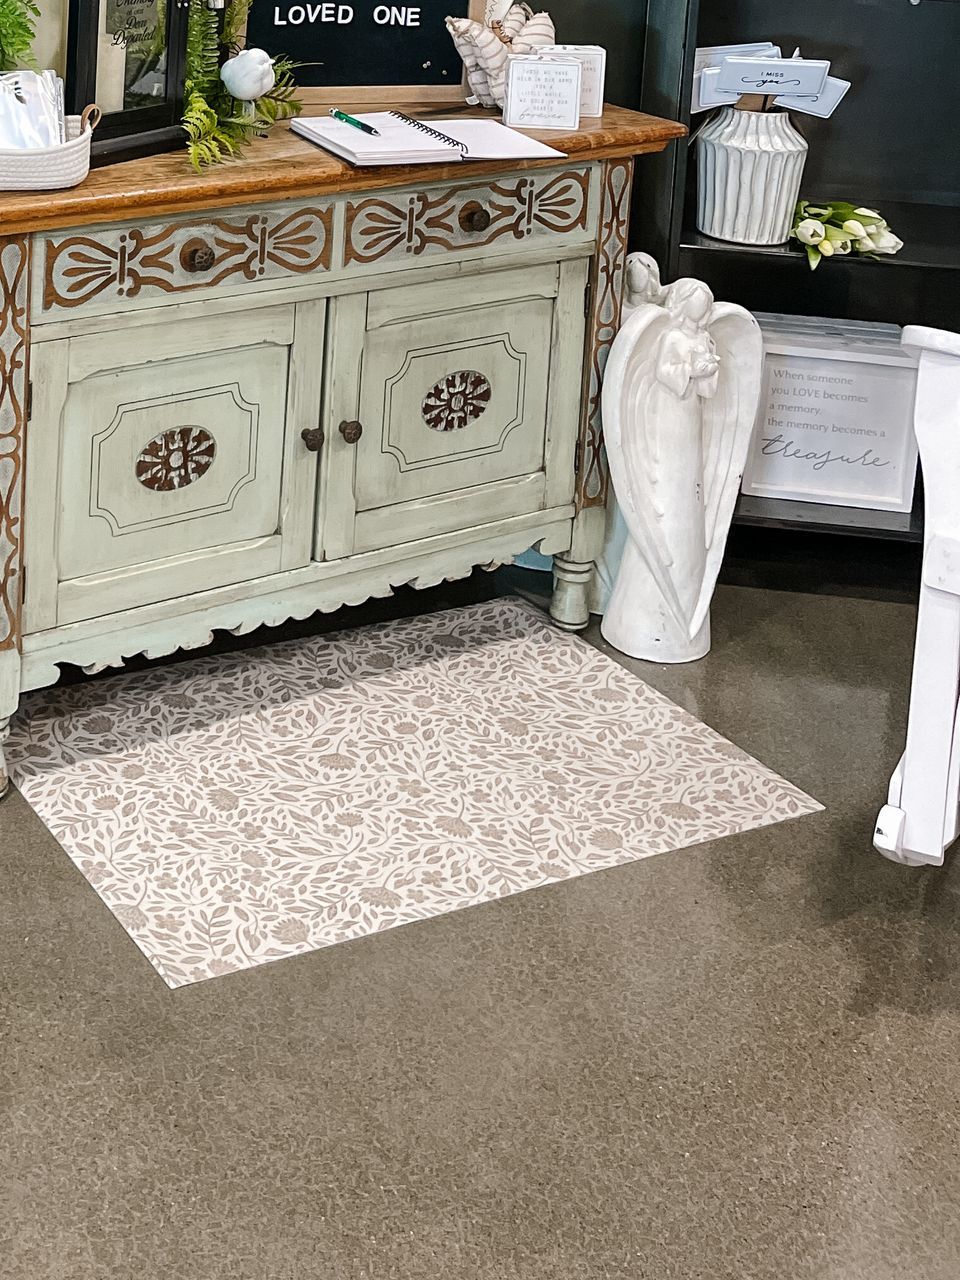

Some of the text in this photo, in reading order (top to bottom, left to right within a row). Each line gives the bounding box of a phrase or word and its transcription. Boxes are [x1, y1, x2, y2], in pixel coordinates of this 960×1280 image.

[273, 2, 421, 27] LOVED ONE
[773, 369, 854, 386] When someone
[771, 387, 869, 403] you LOVE becomes
[768, 417, 877, 437] the memory becomes
